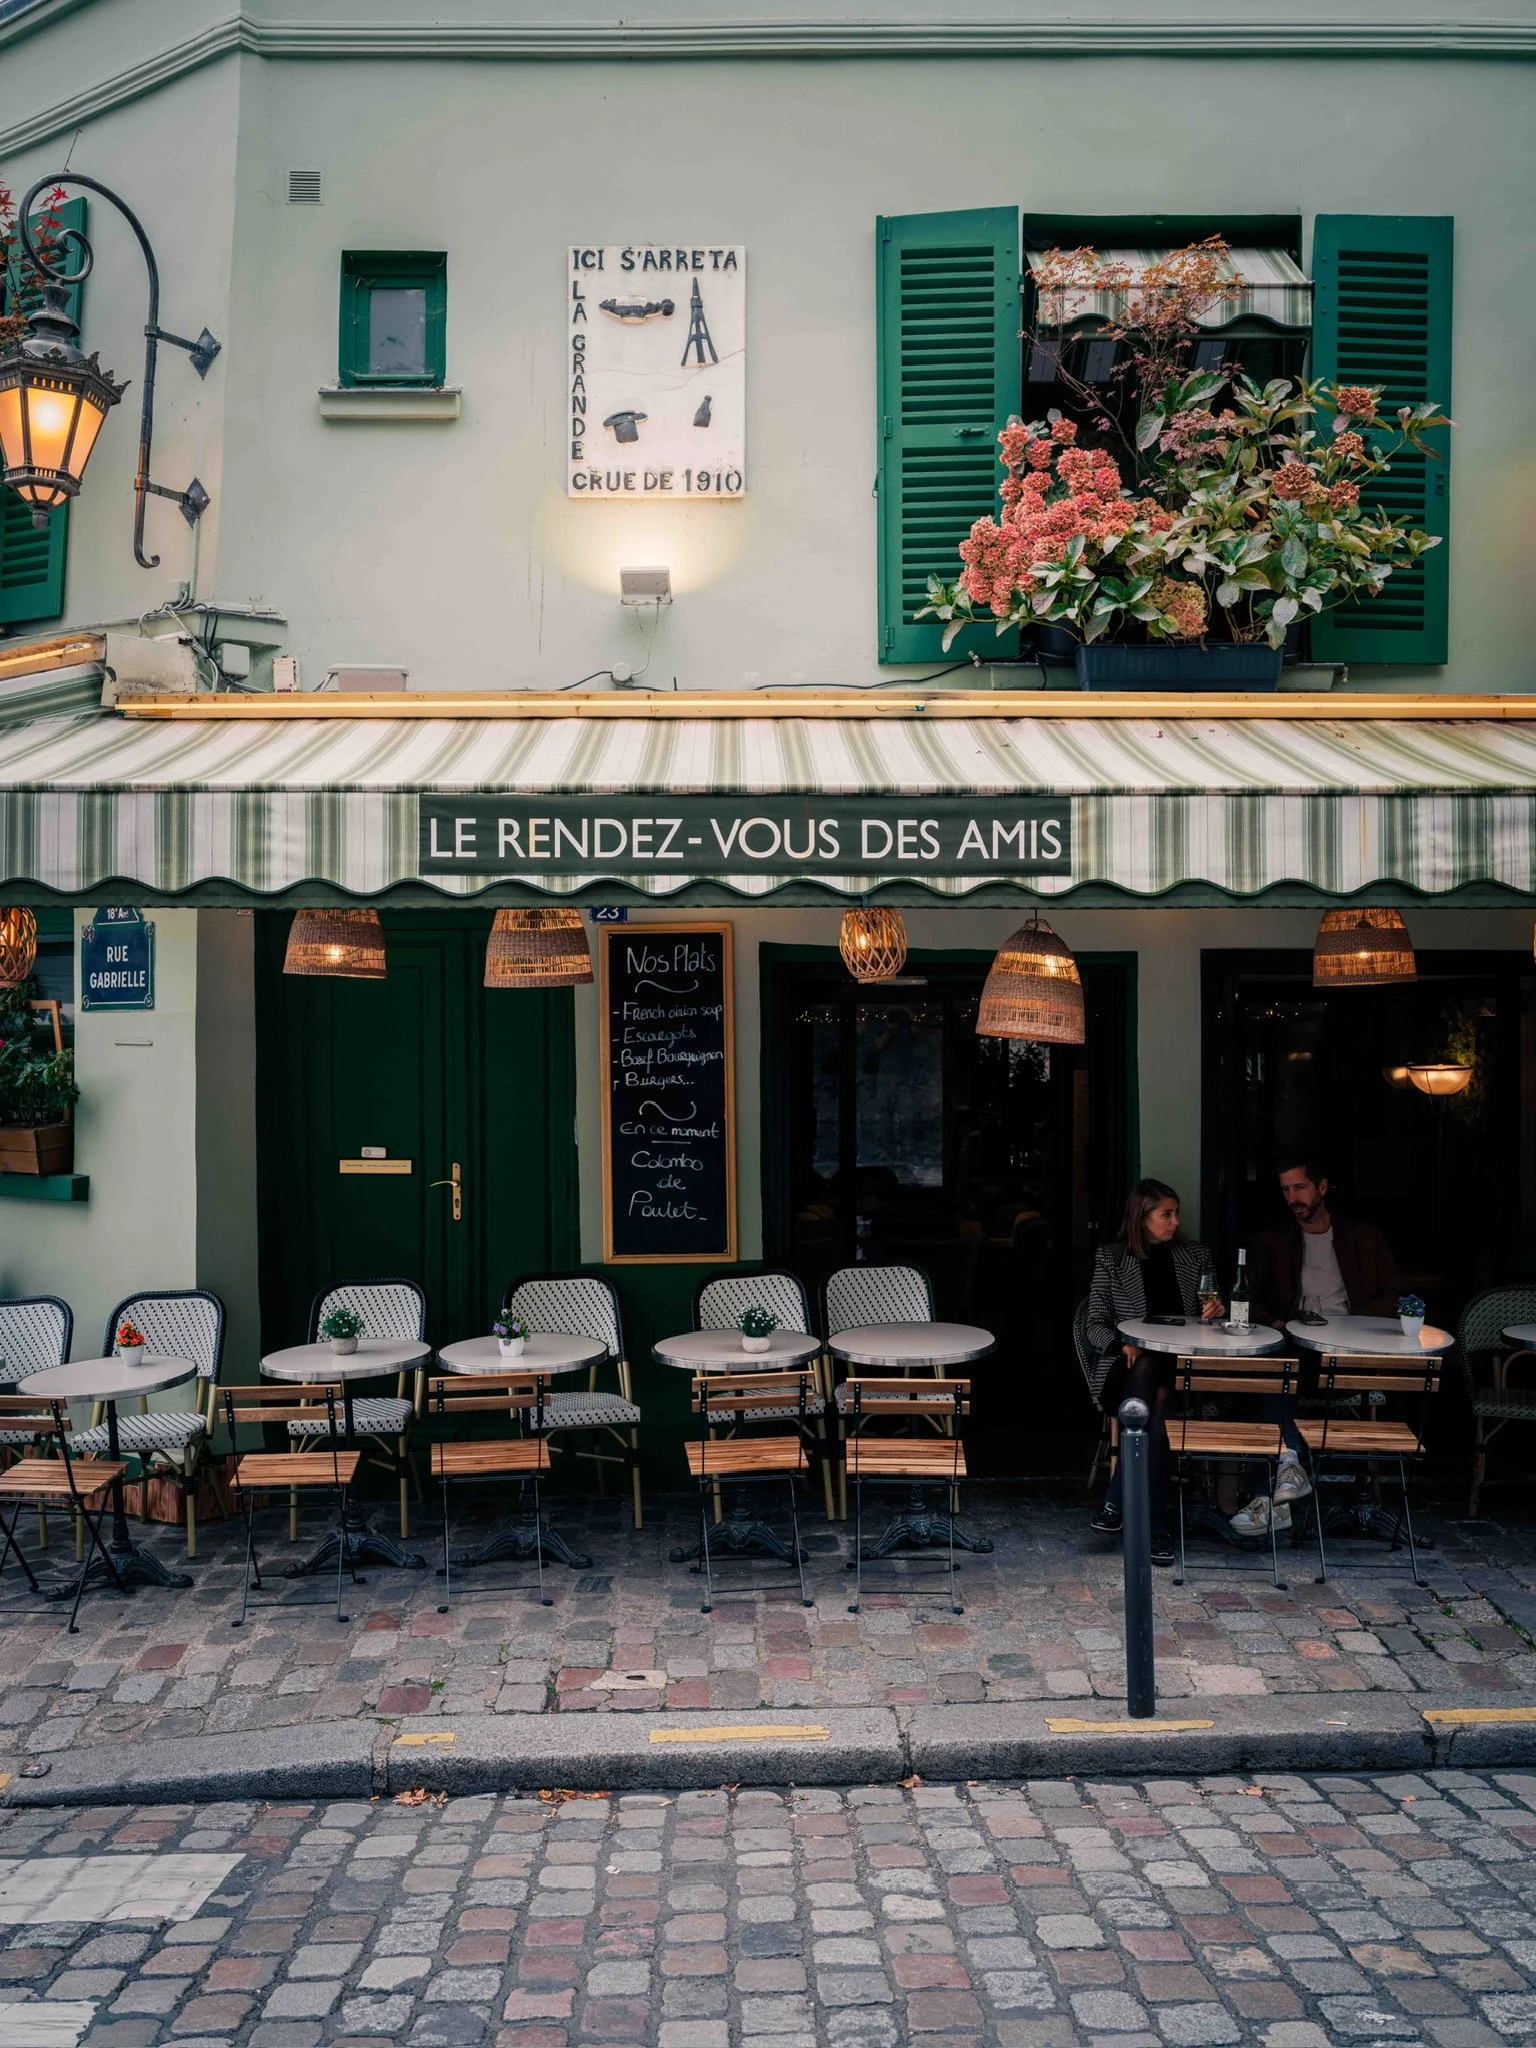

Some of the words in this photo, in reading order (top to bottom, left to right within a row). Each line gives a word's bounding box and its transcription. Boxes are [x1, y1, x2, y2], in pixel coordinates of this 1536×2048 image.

[573, 249, 604, 270] ICI
[621, 249, 738, 271] S'ARRETA
[572, 280, 587, 323] LA
[571, 334, 587, 460] GRANDE
[572, 471, 636, 492] CRUE
[644, 471, 674, 491] DE
[685, 469, 742, 492] 1910
[430, 818, 477, 858] LE
[498, 817, 840, 859] RENDEZ-VOUS
[861, 818, 940, 860] DES
[957, 818, 1062, 860] AMIS
[589, 907, 620, 920] 23
[106, 945, 129, 962] RUE
[627, 945, 670, 974] Nos
[674, 942, 716, 973] Plats
[89, 970, 146, 989] GABRIELLE
[623, 1001, 665, 1021] French
[619, 1121, 646, 1135] En
[650, 1125, 668, 1135] ce
[671, 1121, 720, 1139] moment
[631, 1150, 704, 1171] Colombo
[656, 1174, 687, 1190] de
